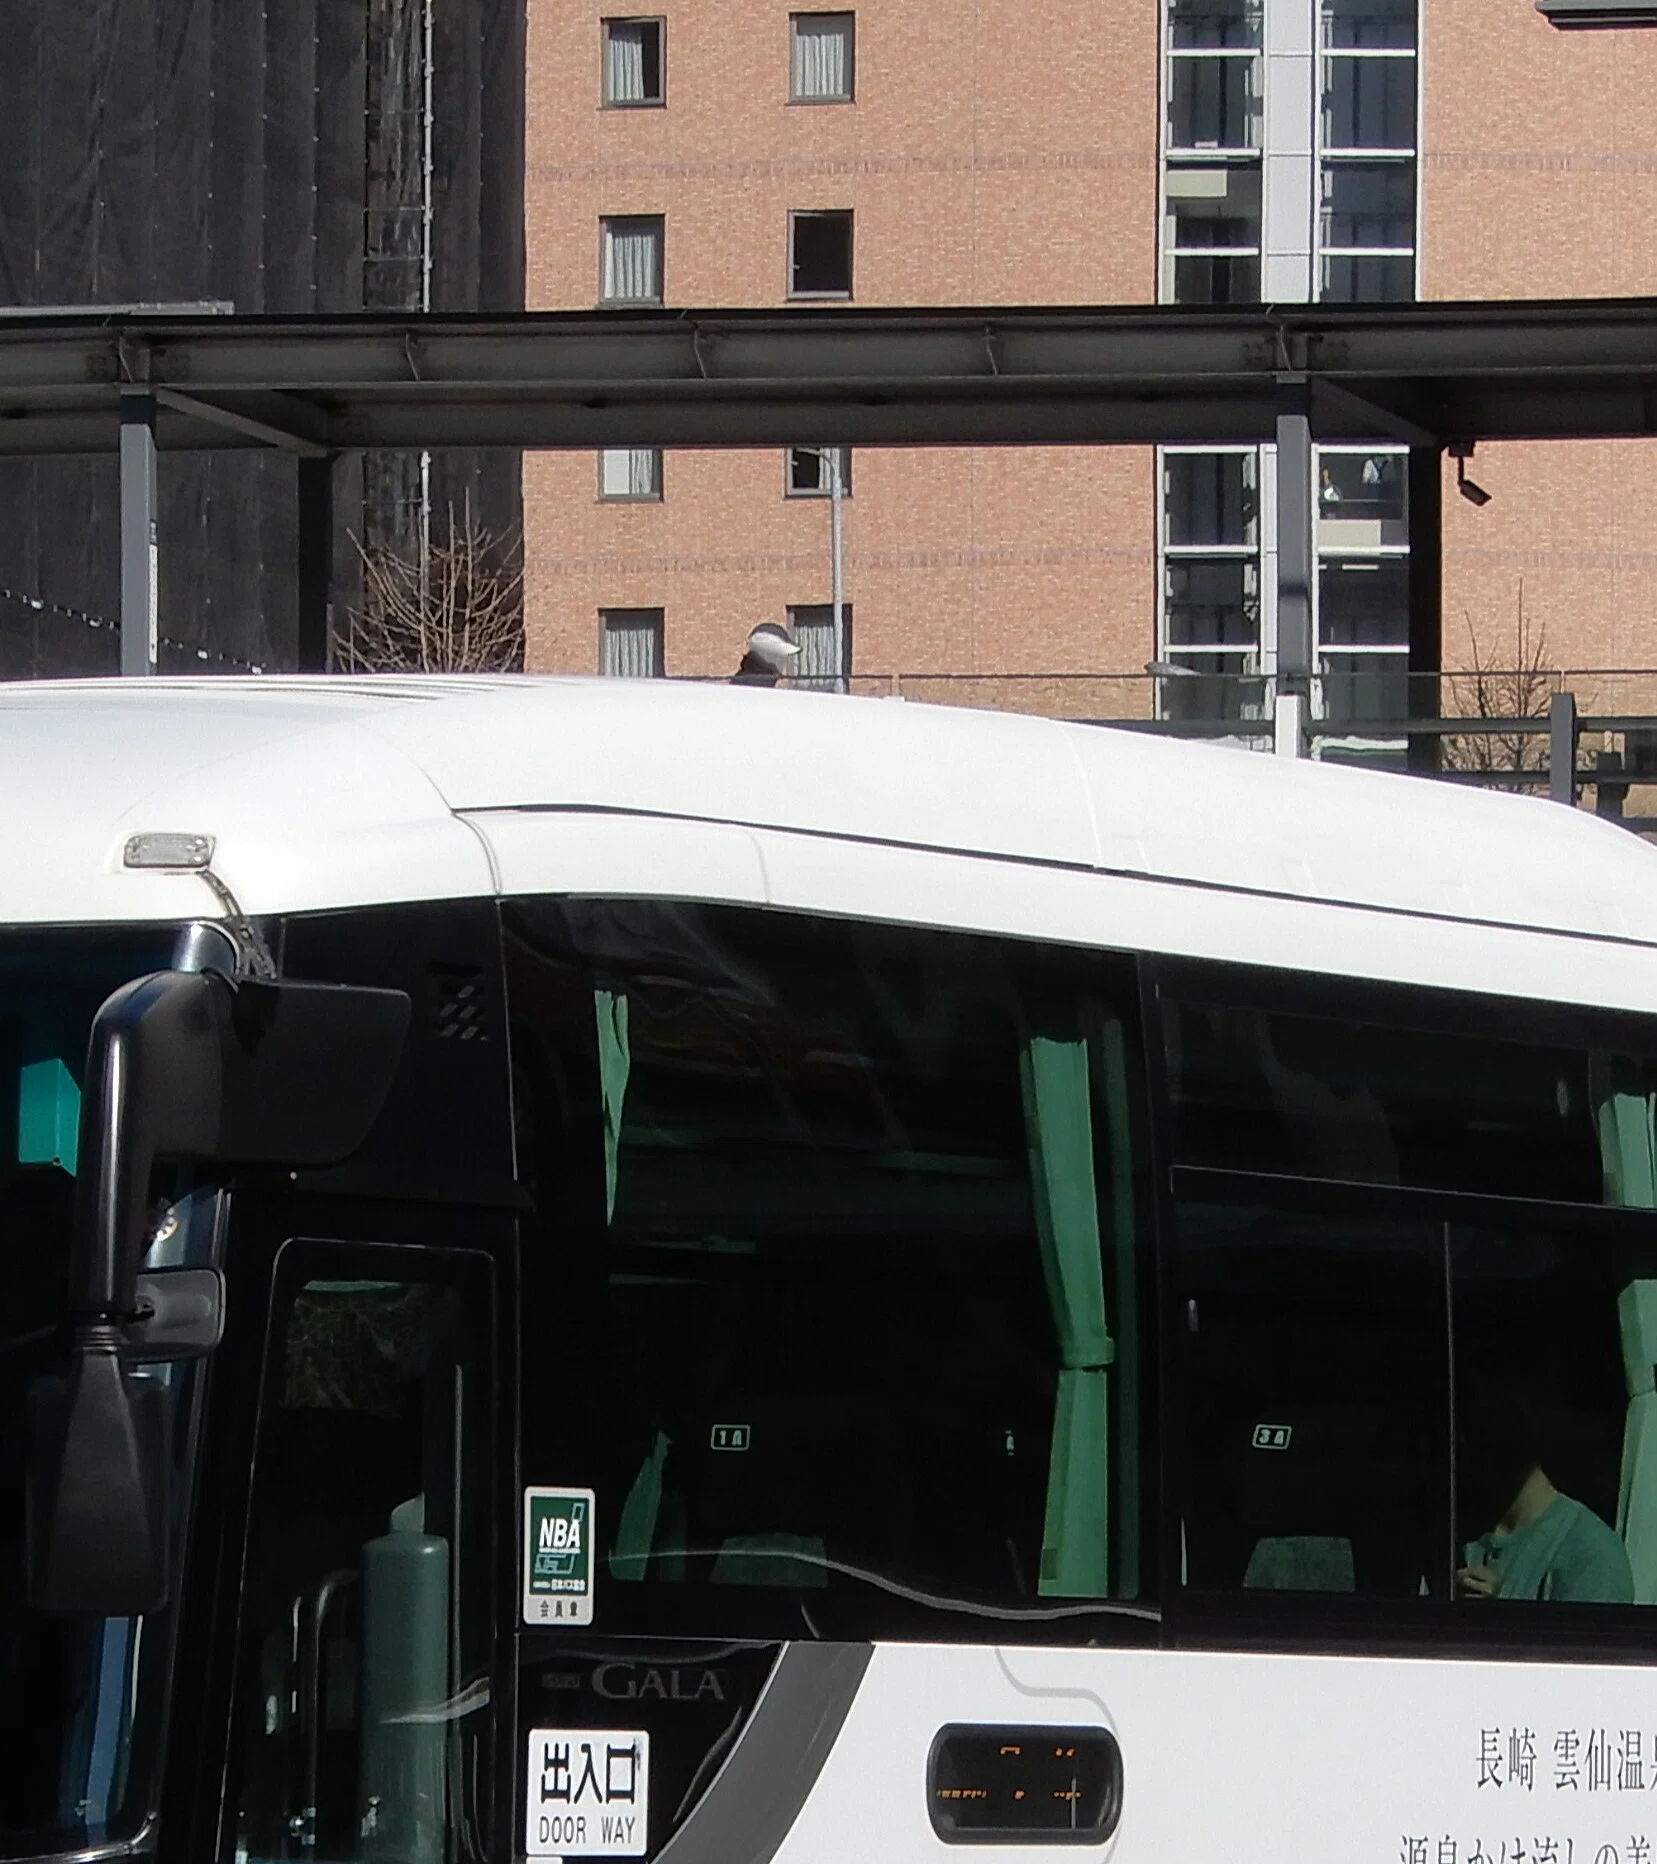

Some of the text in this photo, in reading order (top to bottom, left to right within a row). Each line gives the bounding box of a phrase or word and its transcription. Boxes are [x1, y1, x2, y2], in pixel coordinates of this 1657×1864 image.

[538, 1517, 581, 1548] NBA
[592, 1662, 725, 1700] GALA
[540, 1742, 637, 1805] 出入口
[1475, 1726, 1538, 1792] 長崎
[538, 1815, 636, 1844] DOOR WAY
